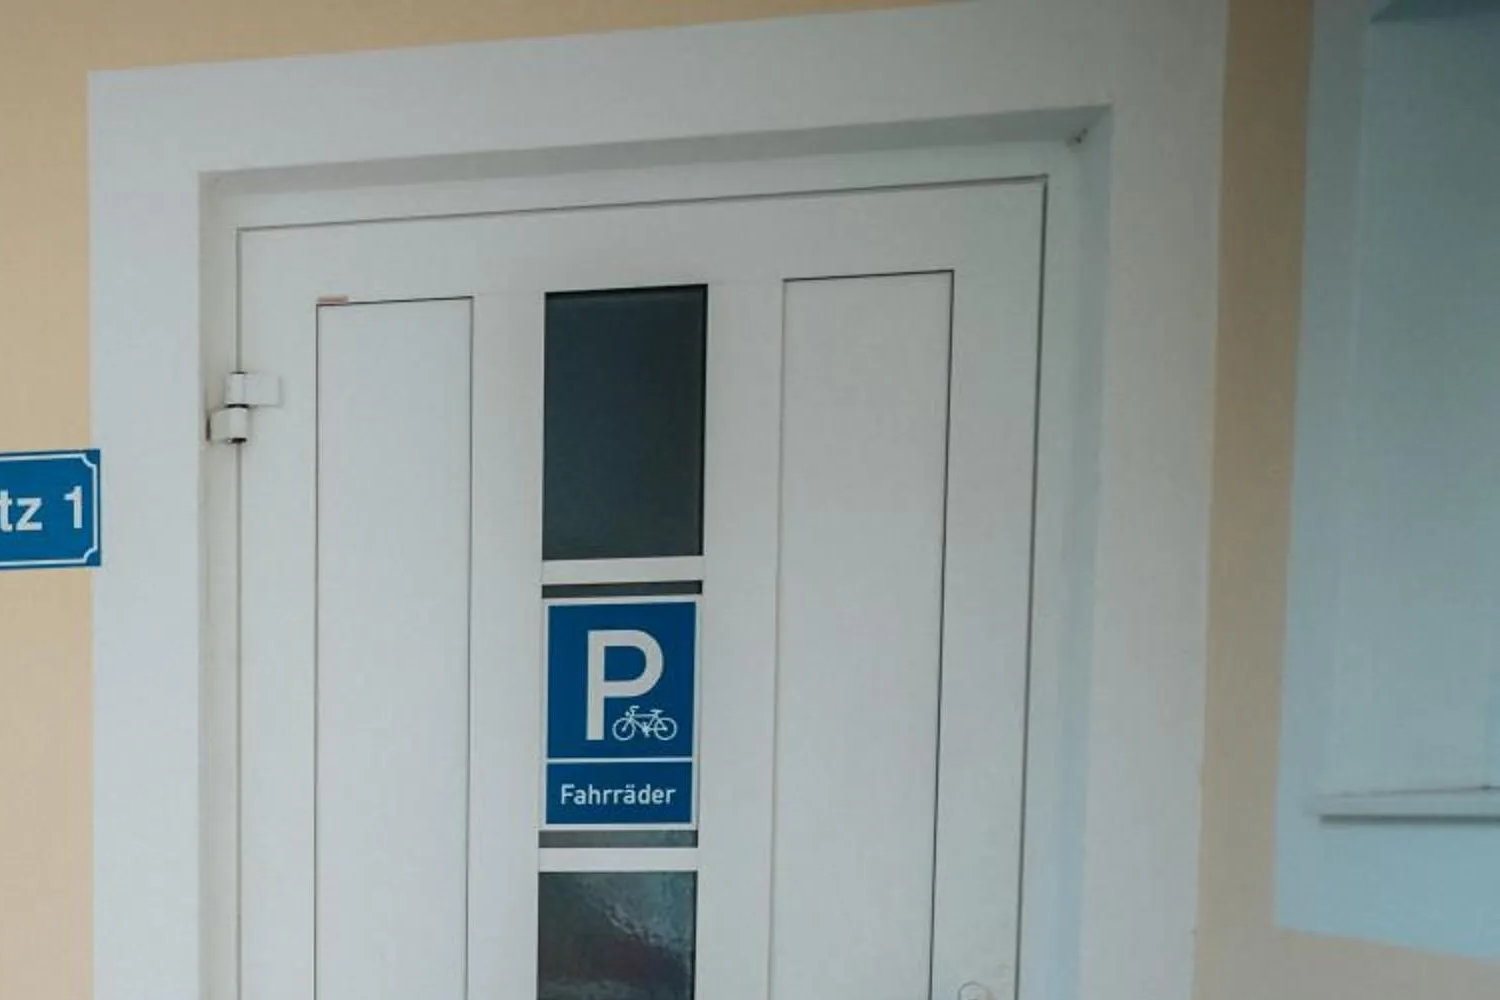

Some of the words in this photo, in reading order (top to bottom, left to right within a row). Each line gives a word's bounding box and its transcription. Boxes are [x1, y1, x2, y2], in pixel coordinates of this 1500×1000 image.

[64, 485, 83, 529] 1
[586, 629, 664, 741] P
[560, 783, 677, 805] Fahrräder
